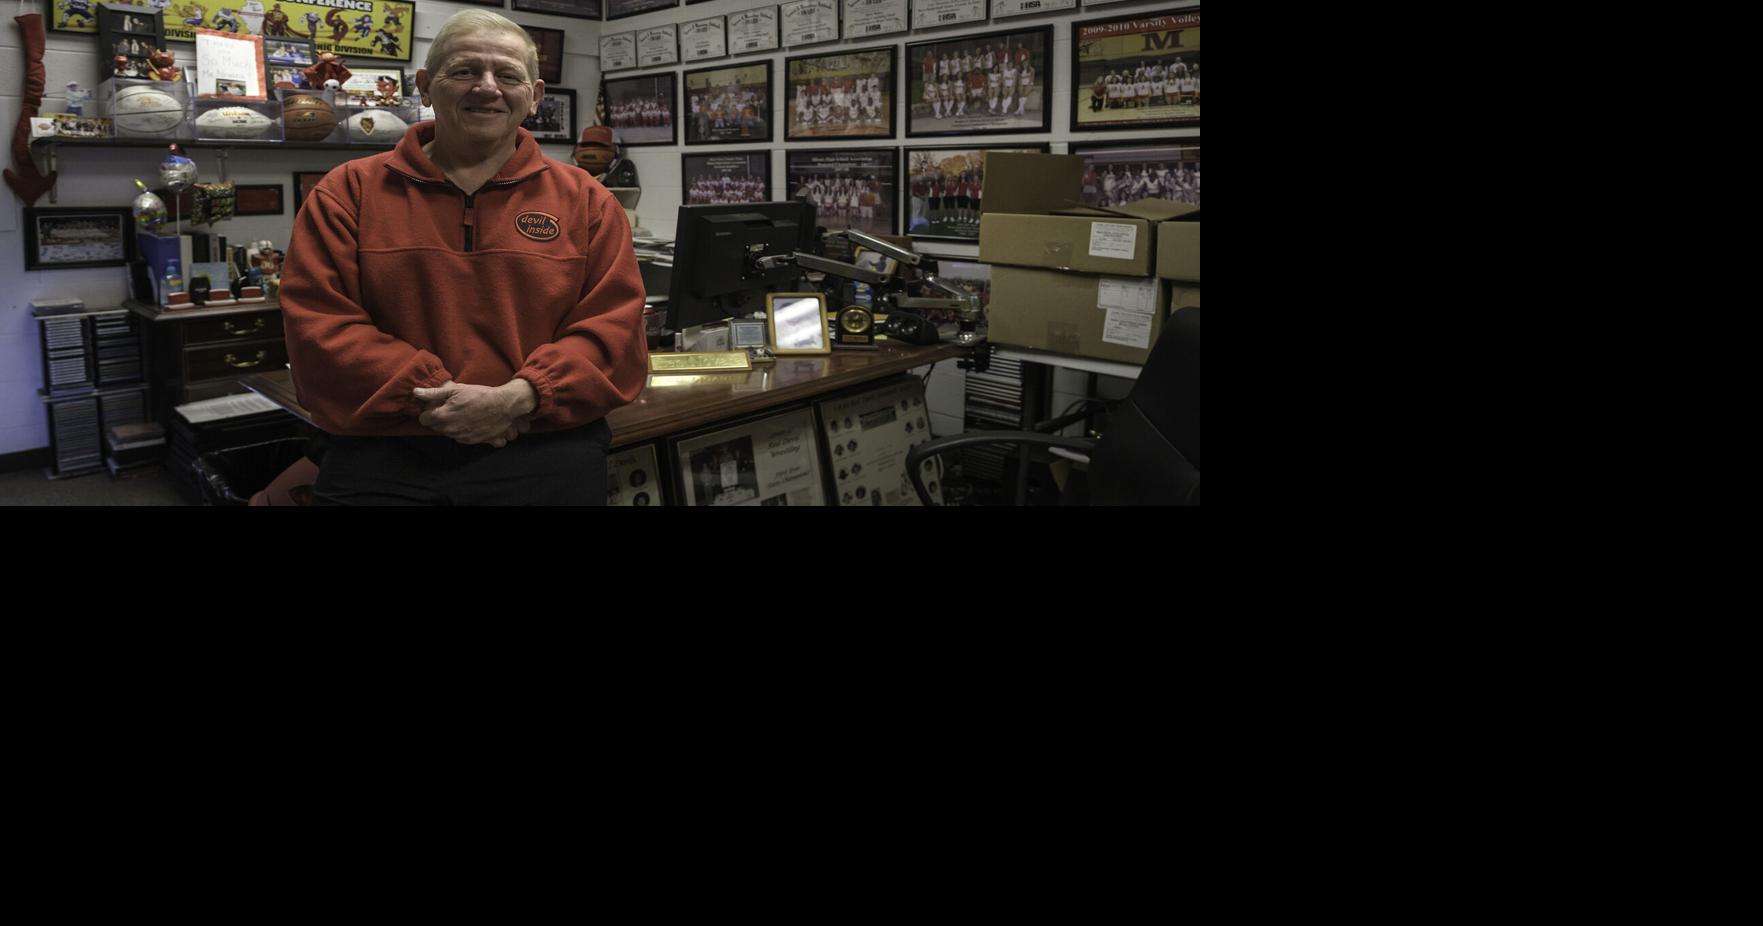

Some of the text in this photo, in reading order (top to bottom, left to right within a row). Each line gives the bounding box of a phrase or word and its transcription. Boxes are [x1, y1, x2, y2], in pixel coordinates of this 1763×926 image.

[1083, 23, 1130, 35] 2009-2010
[1132, 19, 1168, 29] Varsity
[164, 29, 197, 39] DIVISI
[1141, 30, 1185, 52] M
[335, 44, 373, 55] DIVISION
[520, 215, 546, 225] devil
[526, 225, 555, 235] inside
